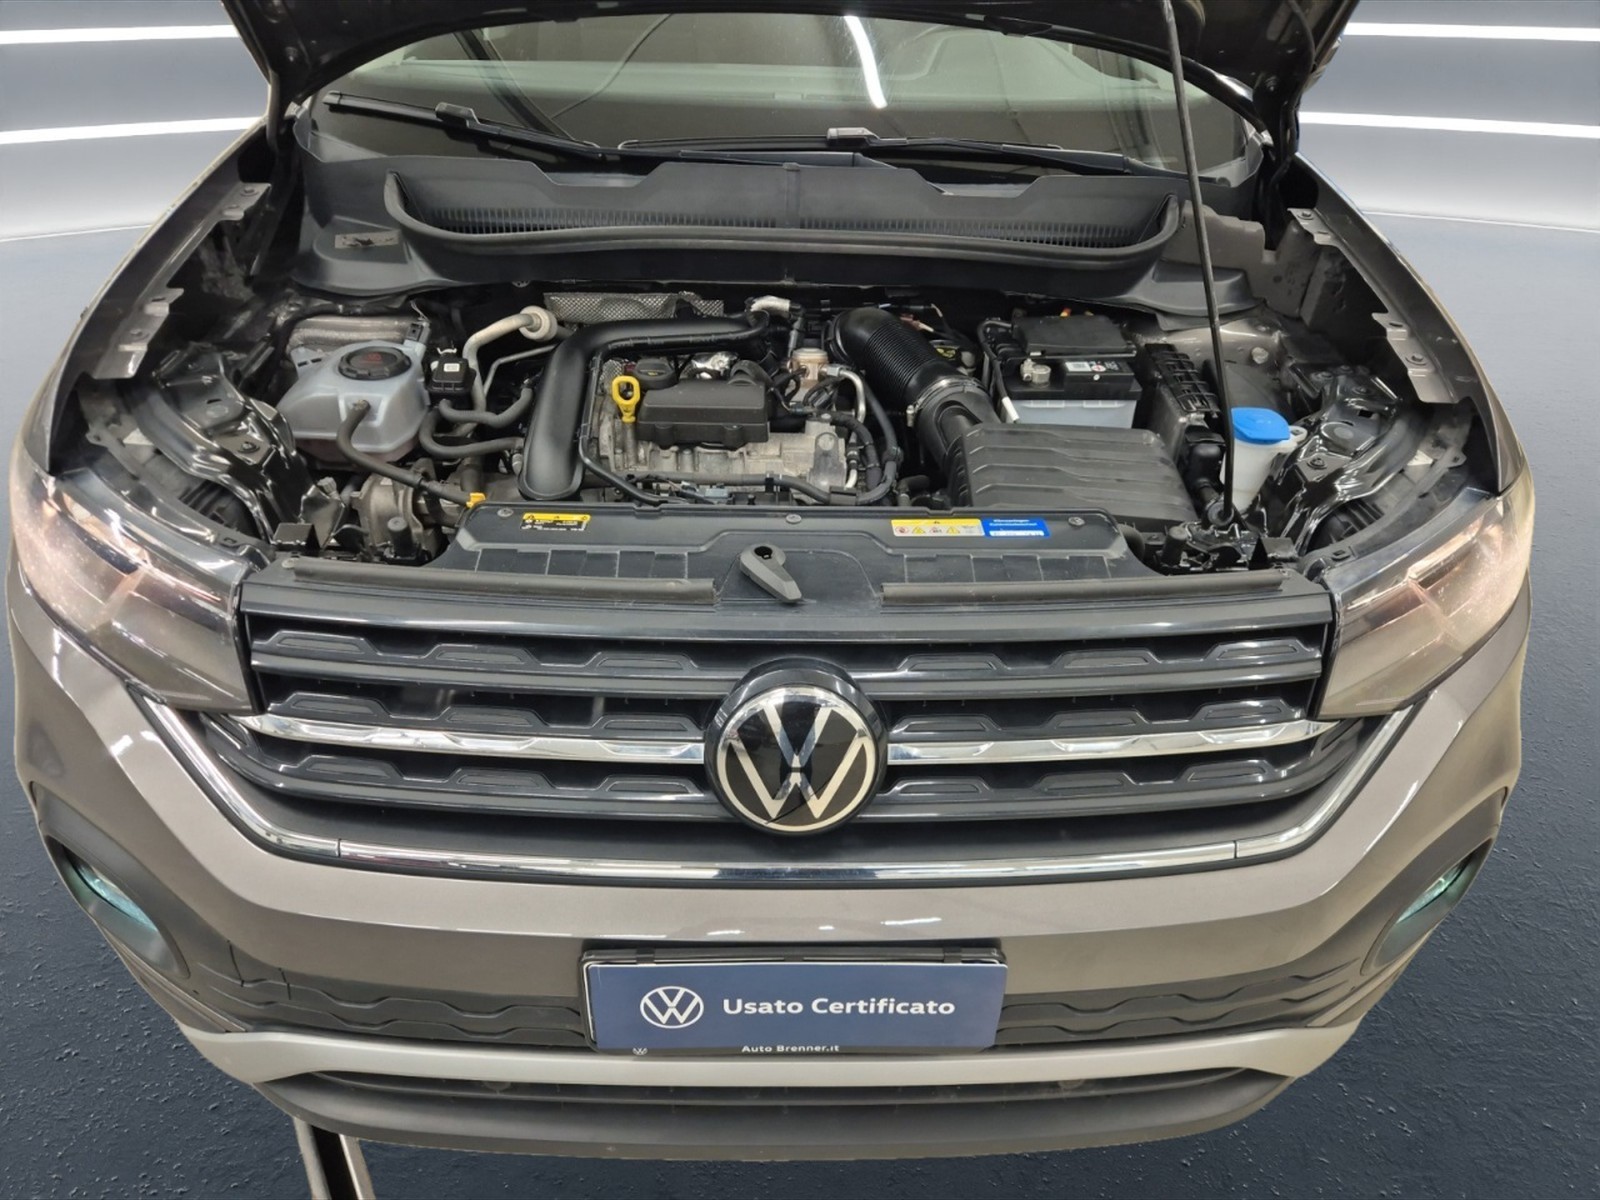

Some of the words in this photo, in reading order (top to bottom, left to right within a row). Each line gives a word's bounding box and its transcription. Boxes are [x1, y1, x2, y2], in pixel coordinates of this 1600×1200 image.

[717, 687, 877, 832] VW
[640, 986, 704, 1029] VW
[722, 998, 803, 1015] Usato
[811, 997, 956, 1015] Certificato
[741, 1044, 773, 1054] Auto
[776, 1044, 840, 1053] Brenner.it
